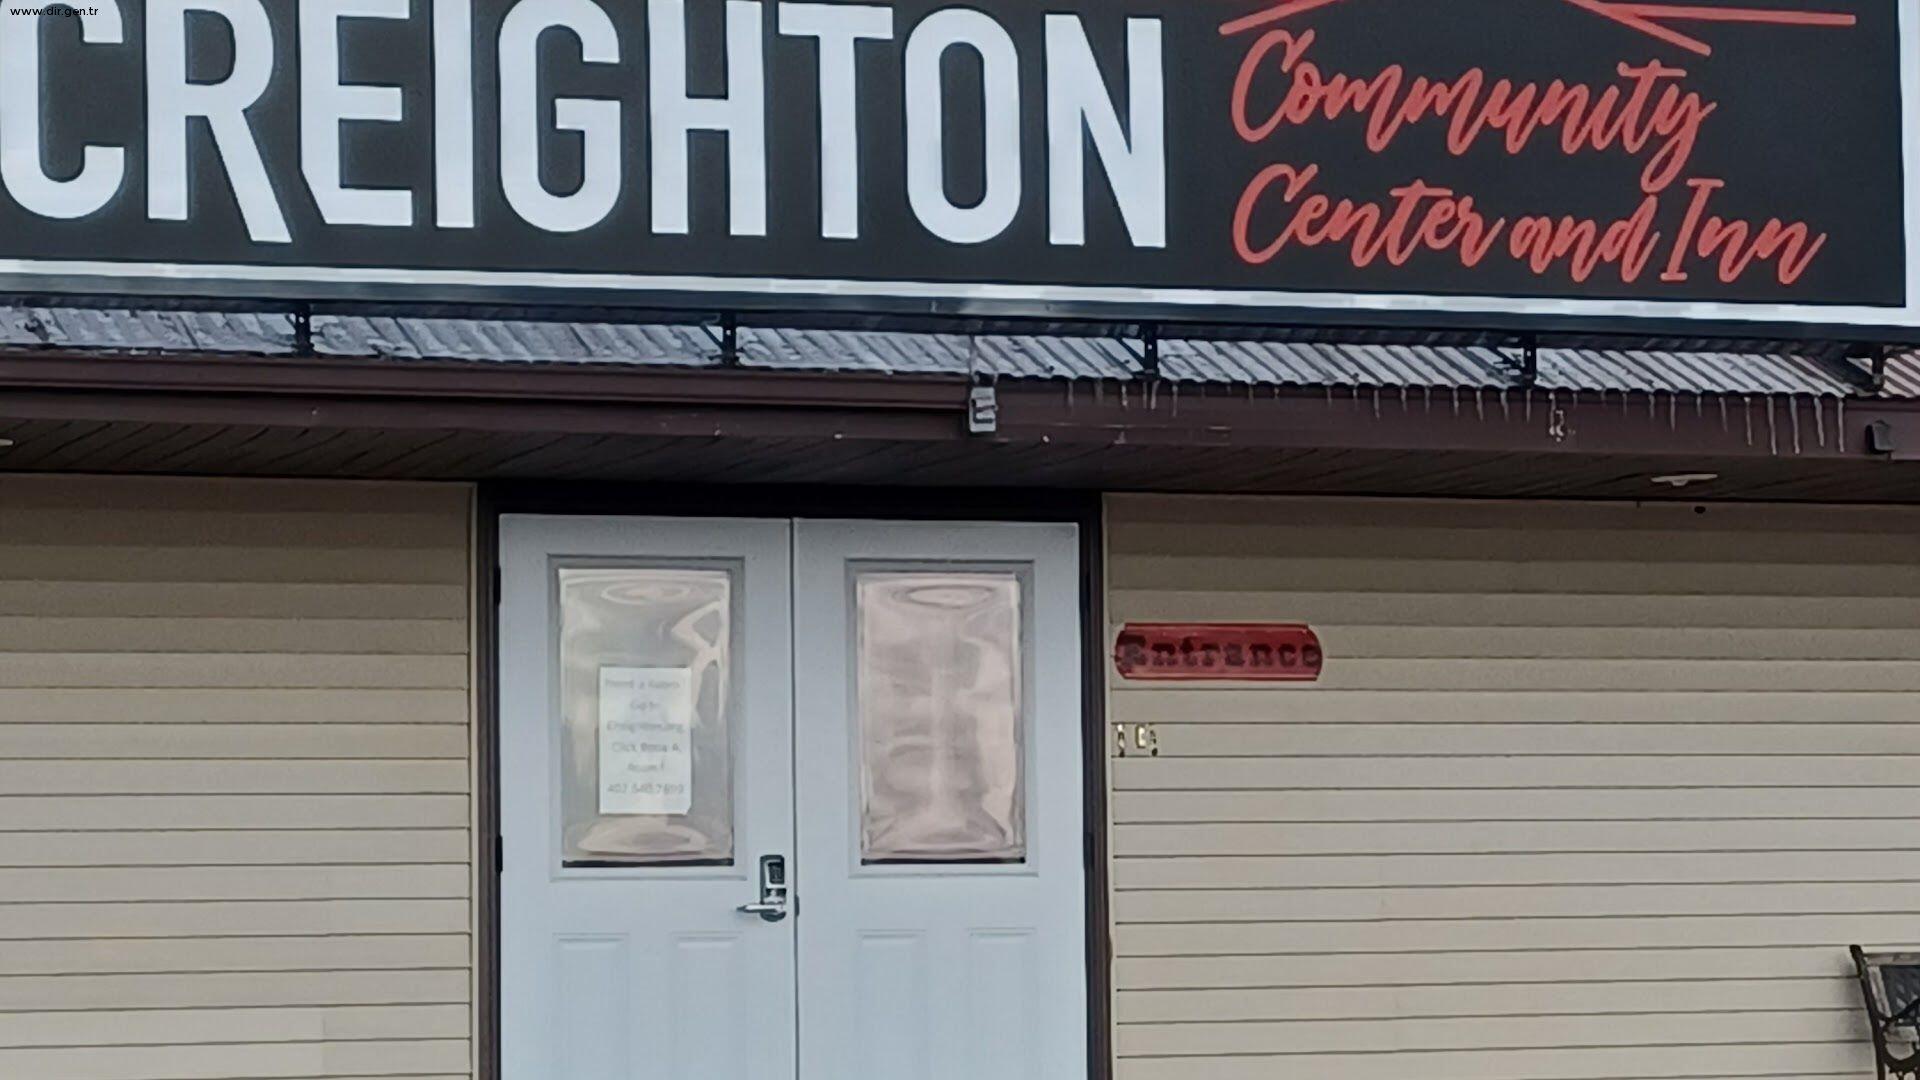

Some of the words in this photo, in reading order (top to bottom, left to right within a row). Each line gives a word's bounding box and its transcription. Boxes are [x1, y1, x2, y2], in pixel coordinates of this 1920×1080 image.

[0, 0, 1166, 248] CREIGHTON
[1231, 29, 1716, 193] Community
[1233, 163, 1504, 267] Center
[1510, 194, 1660, 282] and
[1660, 178, 1826, 284] Inn
